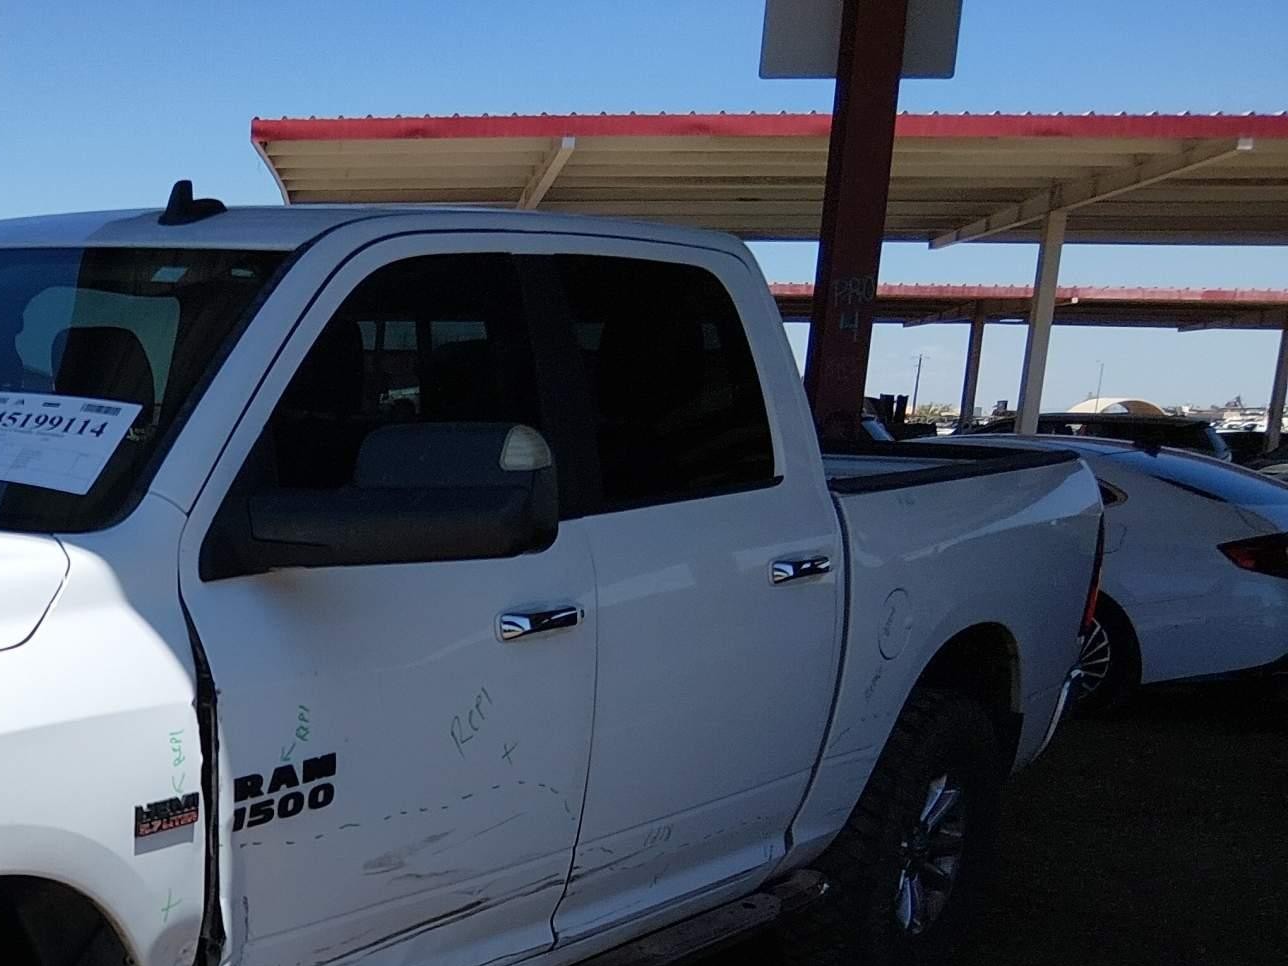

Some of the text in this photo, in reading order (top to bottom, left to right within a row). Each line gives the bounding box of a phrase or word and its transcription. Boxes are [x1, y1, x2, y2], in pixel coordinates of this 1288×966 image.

[233, 752, 337, 803] RAM
[135, 792, 200, 825] HEMI
[232, 782, 335, 833] 1500
